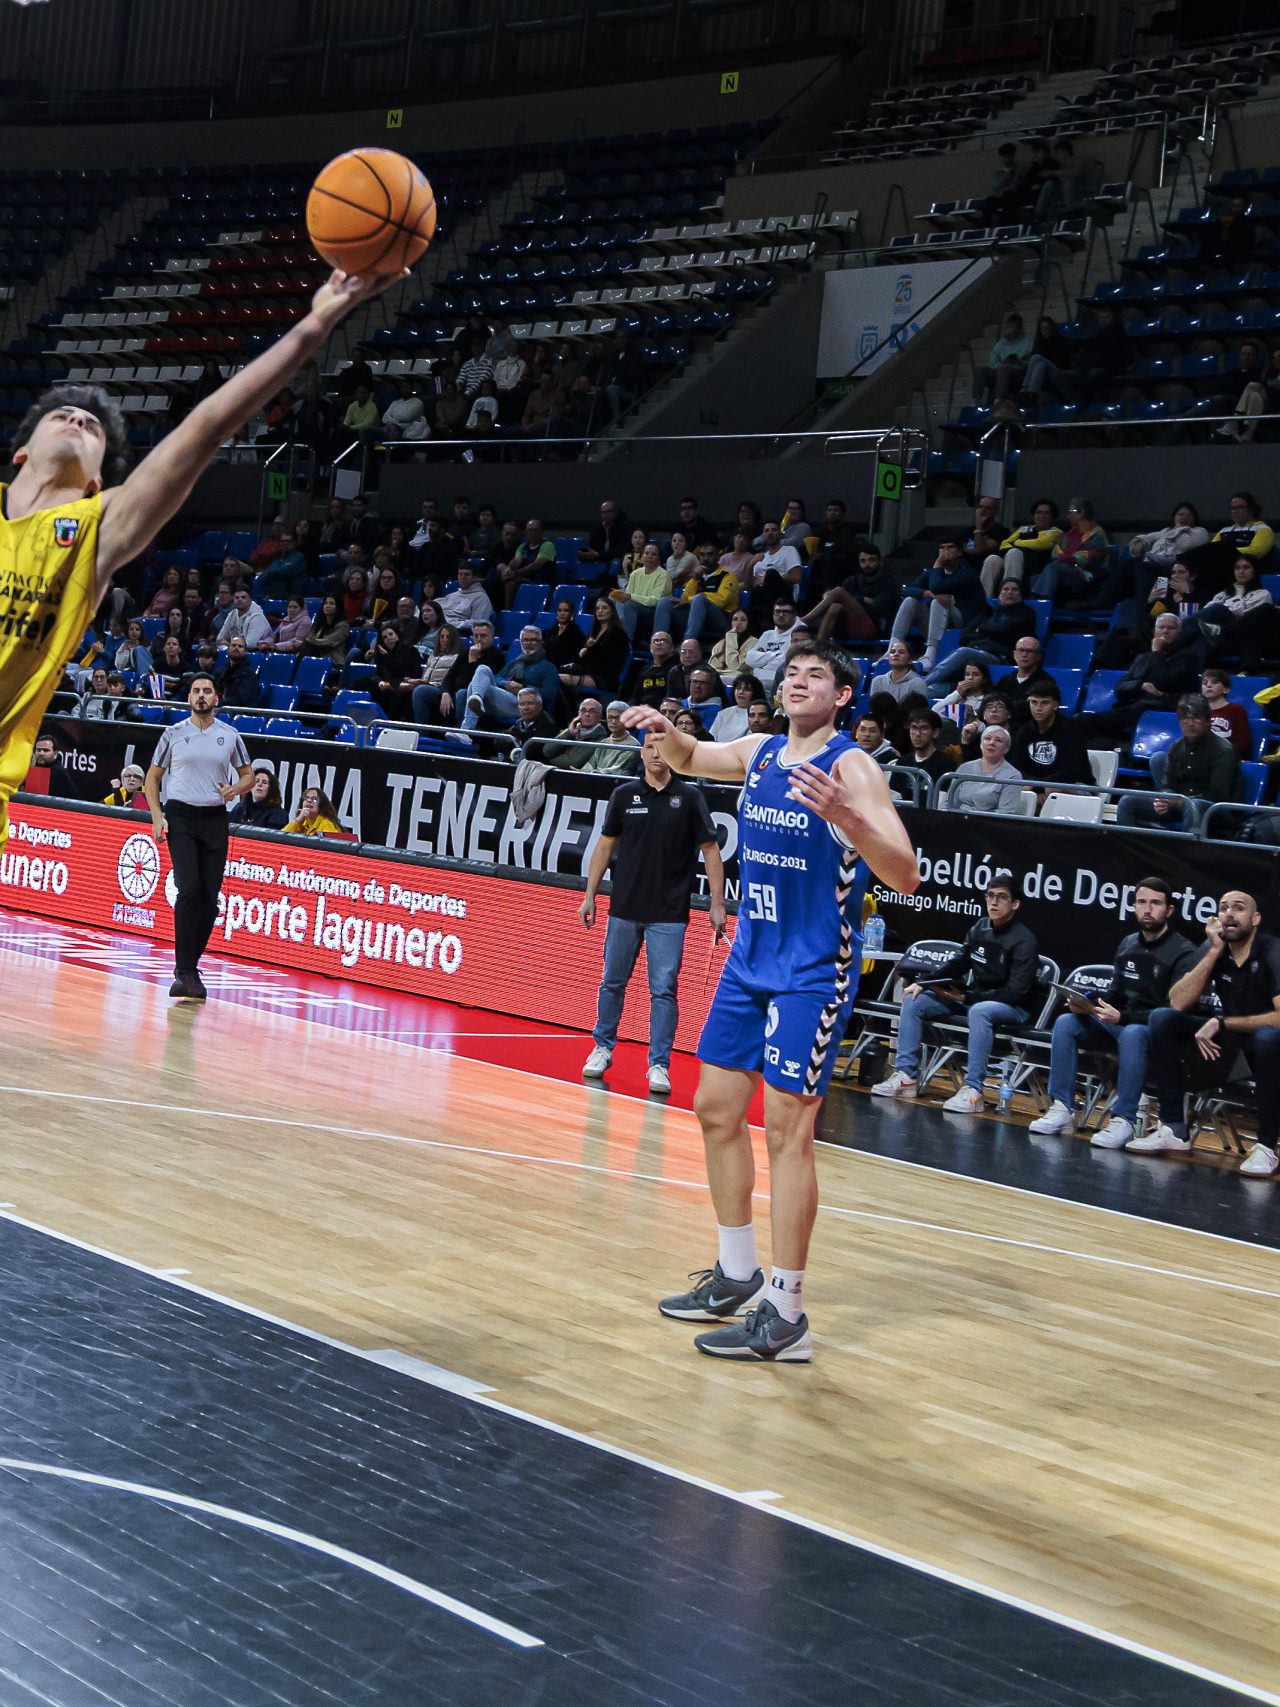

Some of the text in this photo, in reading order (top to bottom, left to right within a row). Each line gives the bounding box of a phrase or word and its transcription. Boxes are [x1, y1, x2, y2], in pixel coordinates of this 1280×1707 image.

[273, 477, 284, 495] N
[882, 470, 897, 492] O
[19, 821, 72, 848] Deportes
[780, 856, 808, 871] 2031
[916, 848, 1013, 890] bellón
[1023, 864, 1062, 900] de
[276, 862, 360, 899] Autónomo
[363, 877, 385, 904] de
[389, 882, 467, 918] Deportes
[748, 882, 778, 922] 59
[872, 885, 982, 917] Santiago Martín
[217, 889, 463, 974] eporte lagunero
[910, 946, 956, 963] tenerif
[1074, 972, 1114, 988] tener
